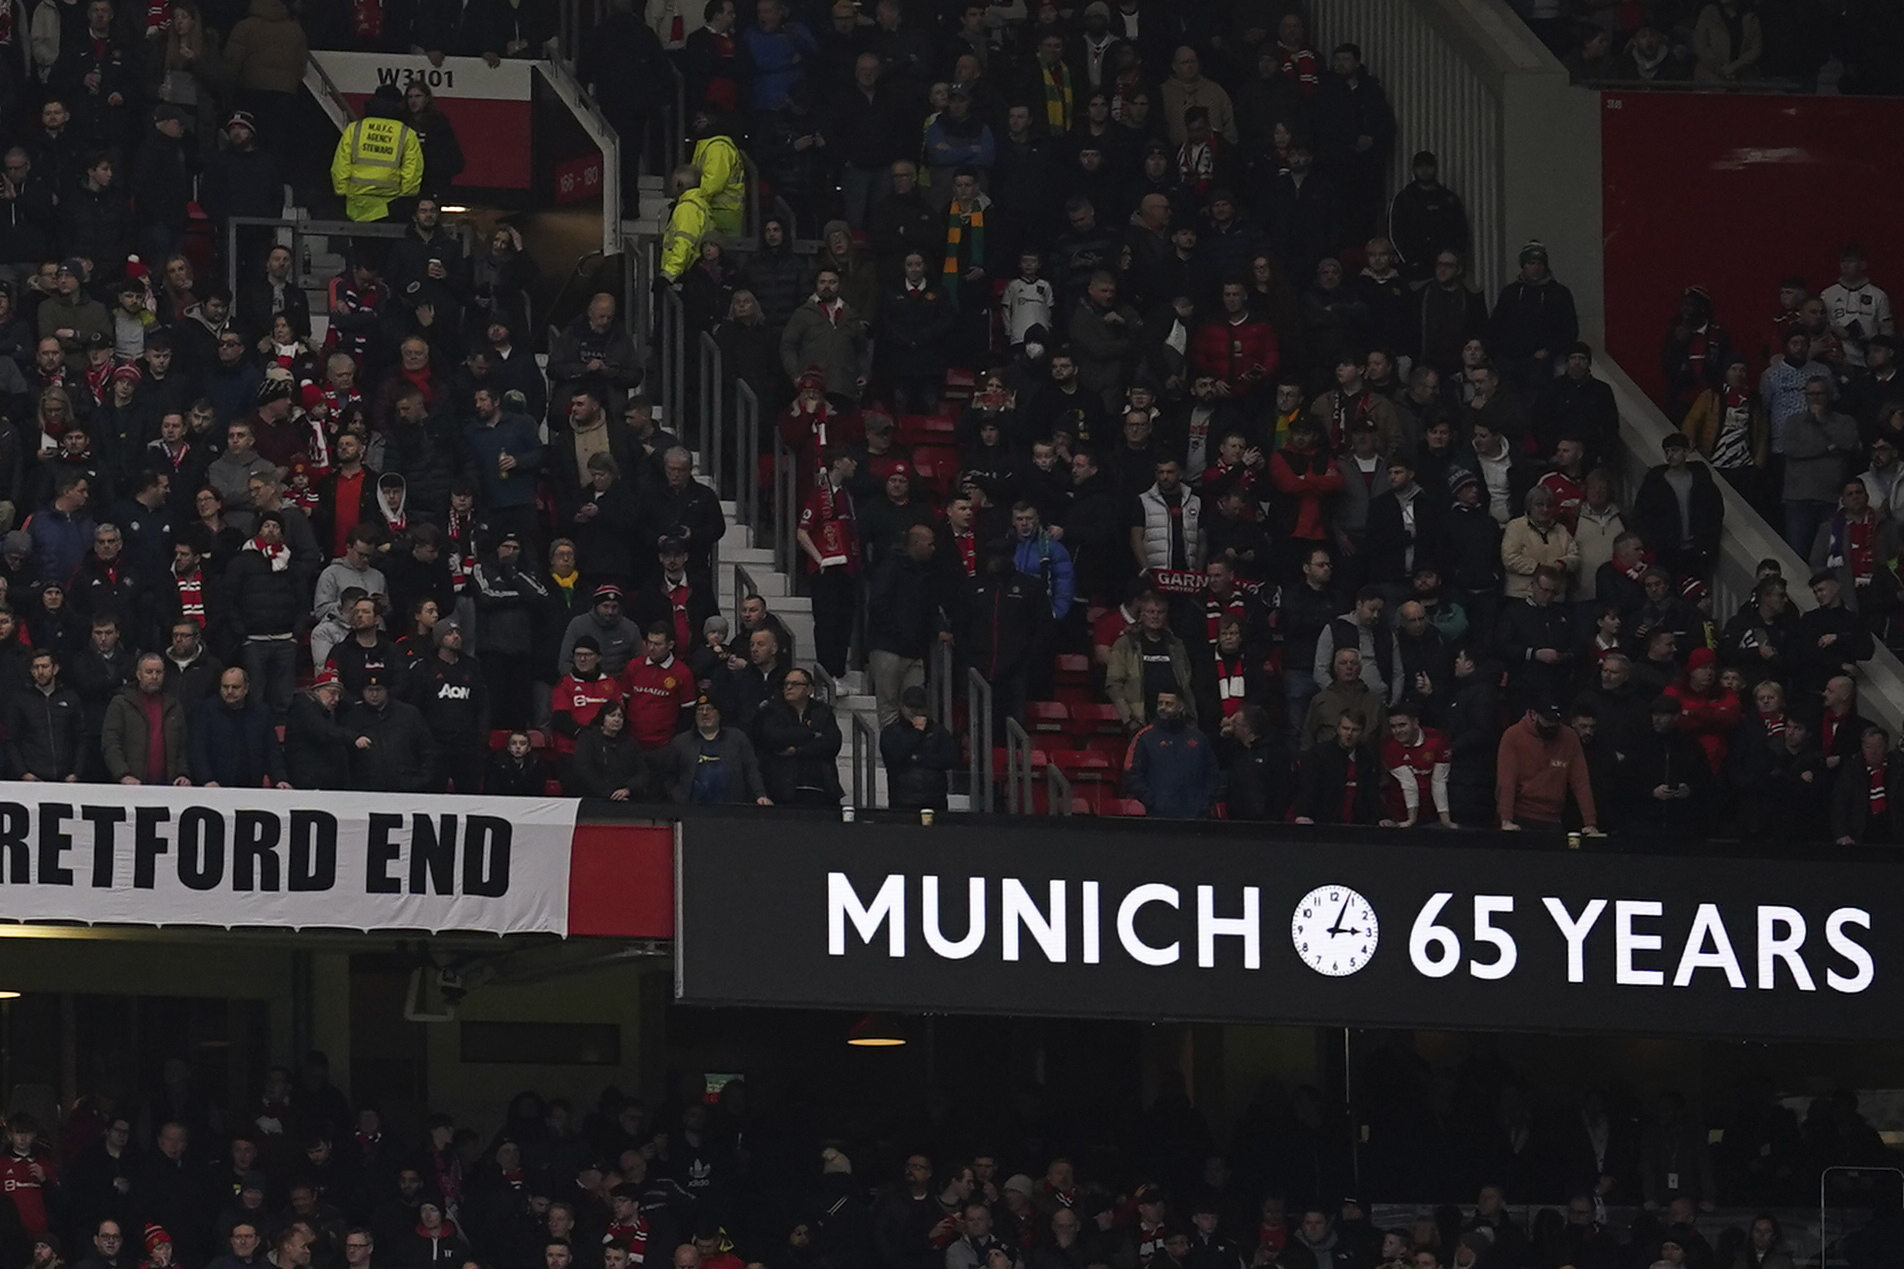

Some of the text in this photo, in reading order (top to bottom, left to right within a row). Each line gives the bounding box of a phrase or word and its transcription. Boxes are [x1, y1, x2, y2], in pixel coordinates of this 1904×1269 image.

[377, 67, 454, 90] W3101
[366, 133, 393, 144] AGENCY
[362, 142, 394, 156] STEWARD
[633, 685, 670, 698] SHARP
[366, 813, 512, 897] END
[829, 873, 1873, 992] MUNICH 65 YEARS
